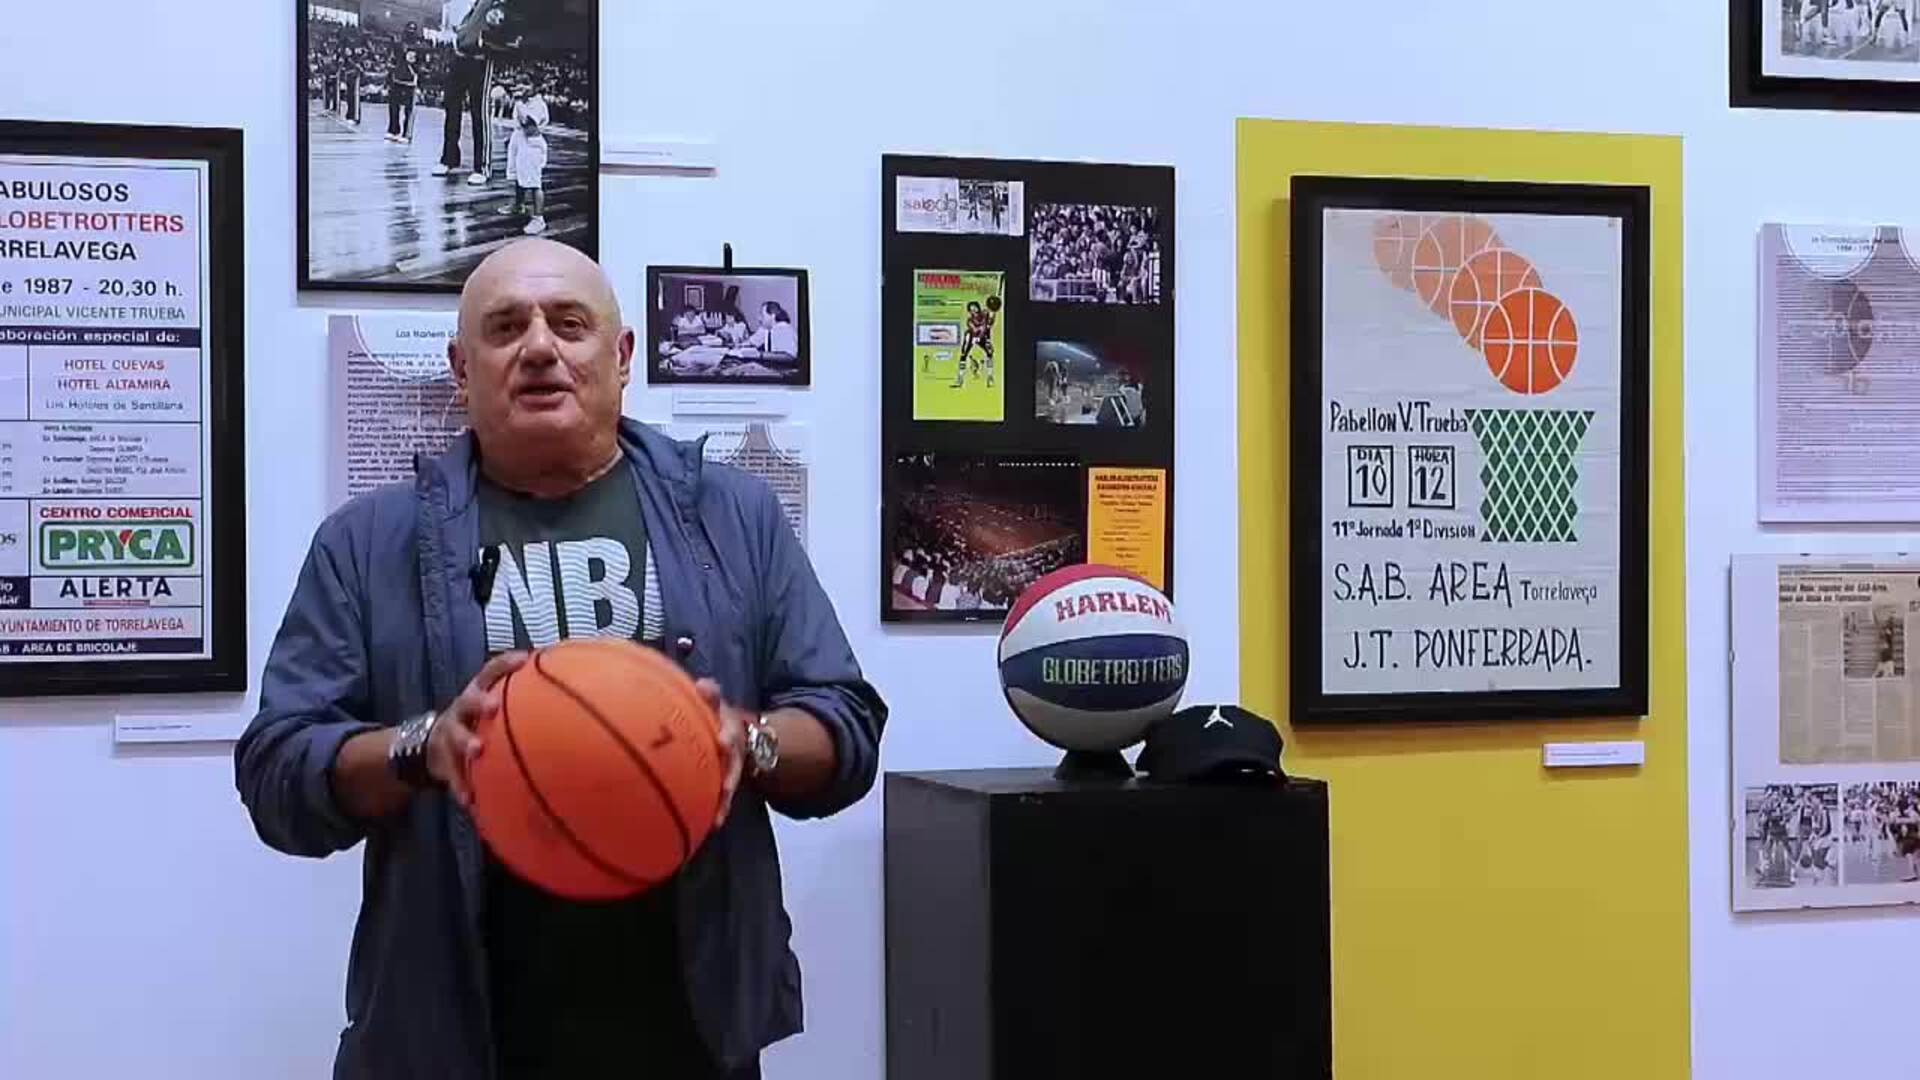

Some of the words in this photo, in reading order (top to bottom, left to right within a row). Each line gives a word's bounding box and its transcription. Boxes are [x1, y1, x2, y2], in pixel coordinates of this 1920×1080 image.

[0, 180, 129, 202] ABULOSOS
[24, 278, 73, 295] 1987
[99, 279, 157, 298] 20,30
[165, 281, 183, 297] h.
[66, 306, 126, 319] VICENTE
[130, 307, 185, 320] TRUEBA
[84, 330, 150, 345] especial
[64, 359, 106, 370] HOTEL
[112, 359, 165, 370] CUEVAS
[58, 379, 100, 390] HOTEL
[106, 379, 170, 390] ALTAMIRA
[1356, 465, 1387, 498] 10
[1414, 466, 1446, 500] 12
[40, 507, 101, 518] CENTRO
[107, 507, 193, 519] COMERCIAL
[49, 529, 185, 560] PRYCA
[59, 577, 172, 598] ALERTA
[1333, 562, 1412, 605] S.A.B.
[1429, 562, 1513, 608] AREA
[1520, 580, 1597, 604] Torrelavega
[1055, 591, 1172, 624] HARLEM
[86, 619, 101, 631] DE
[106, 617, 184, 632] TORRELAVEGA
[22, 643, 53, 653] AREA
[57, 643, 73, 652] DE
[76, 642, 137, 653] BRICOLAJE
[1343, 630, 1398, 669] J.T.
[1415, 628, 1592, 672] PONFERRADA.
[1042, 653, 1183, 685] GLOBETROTTERS
